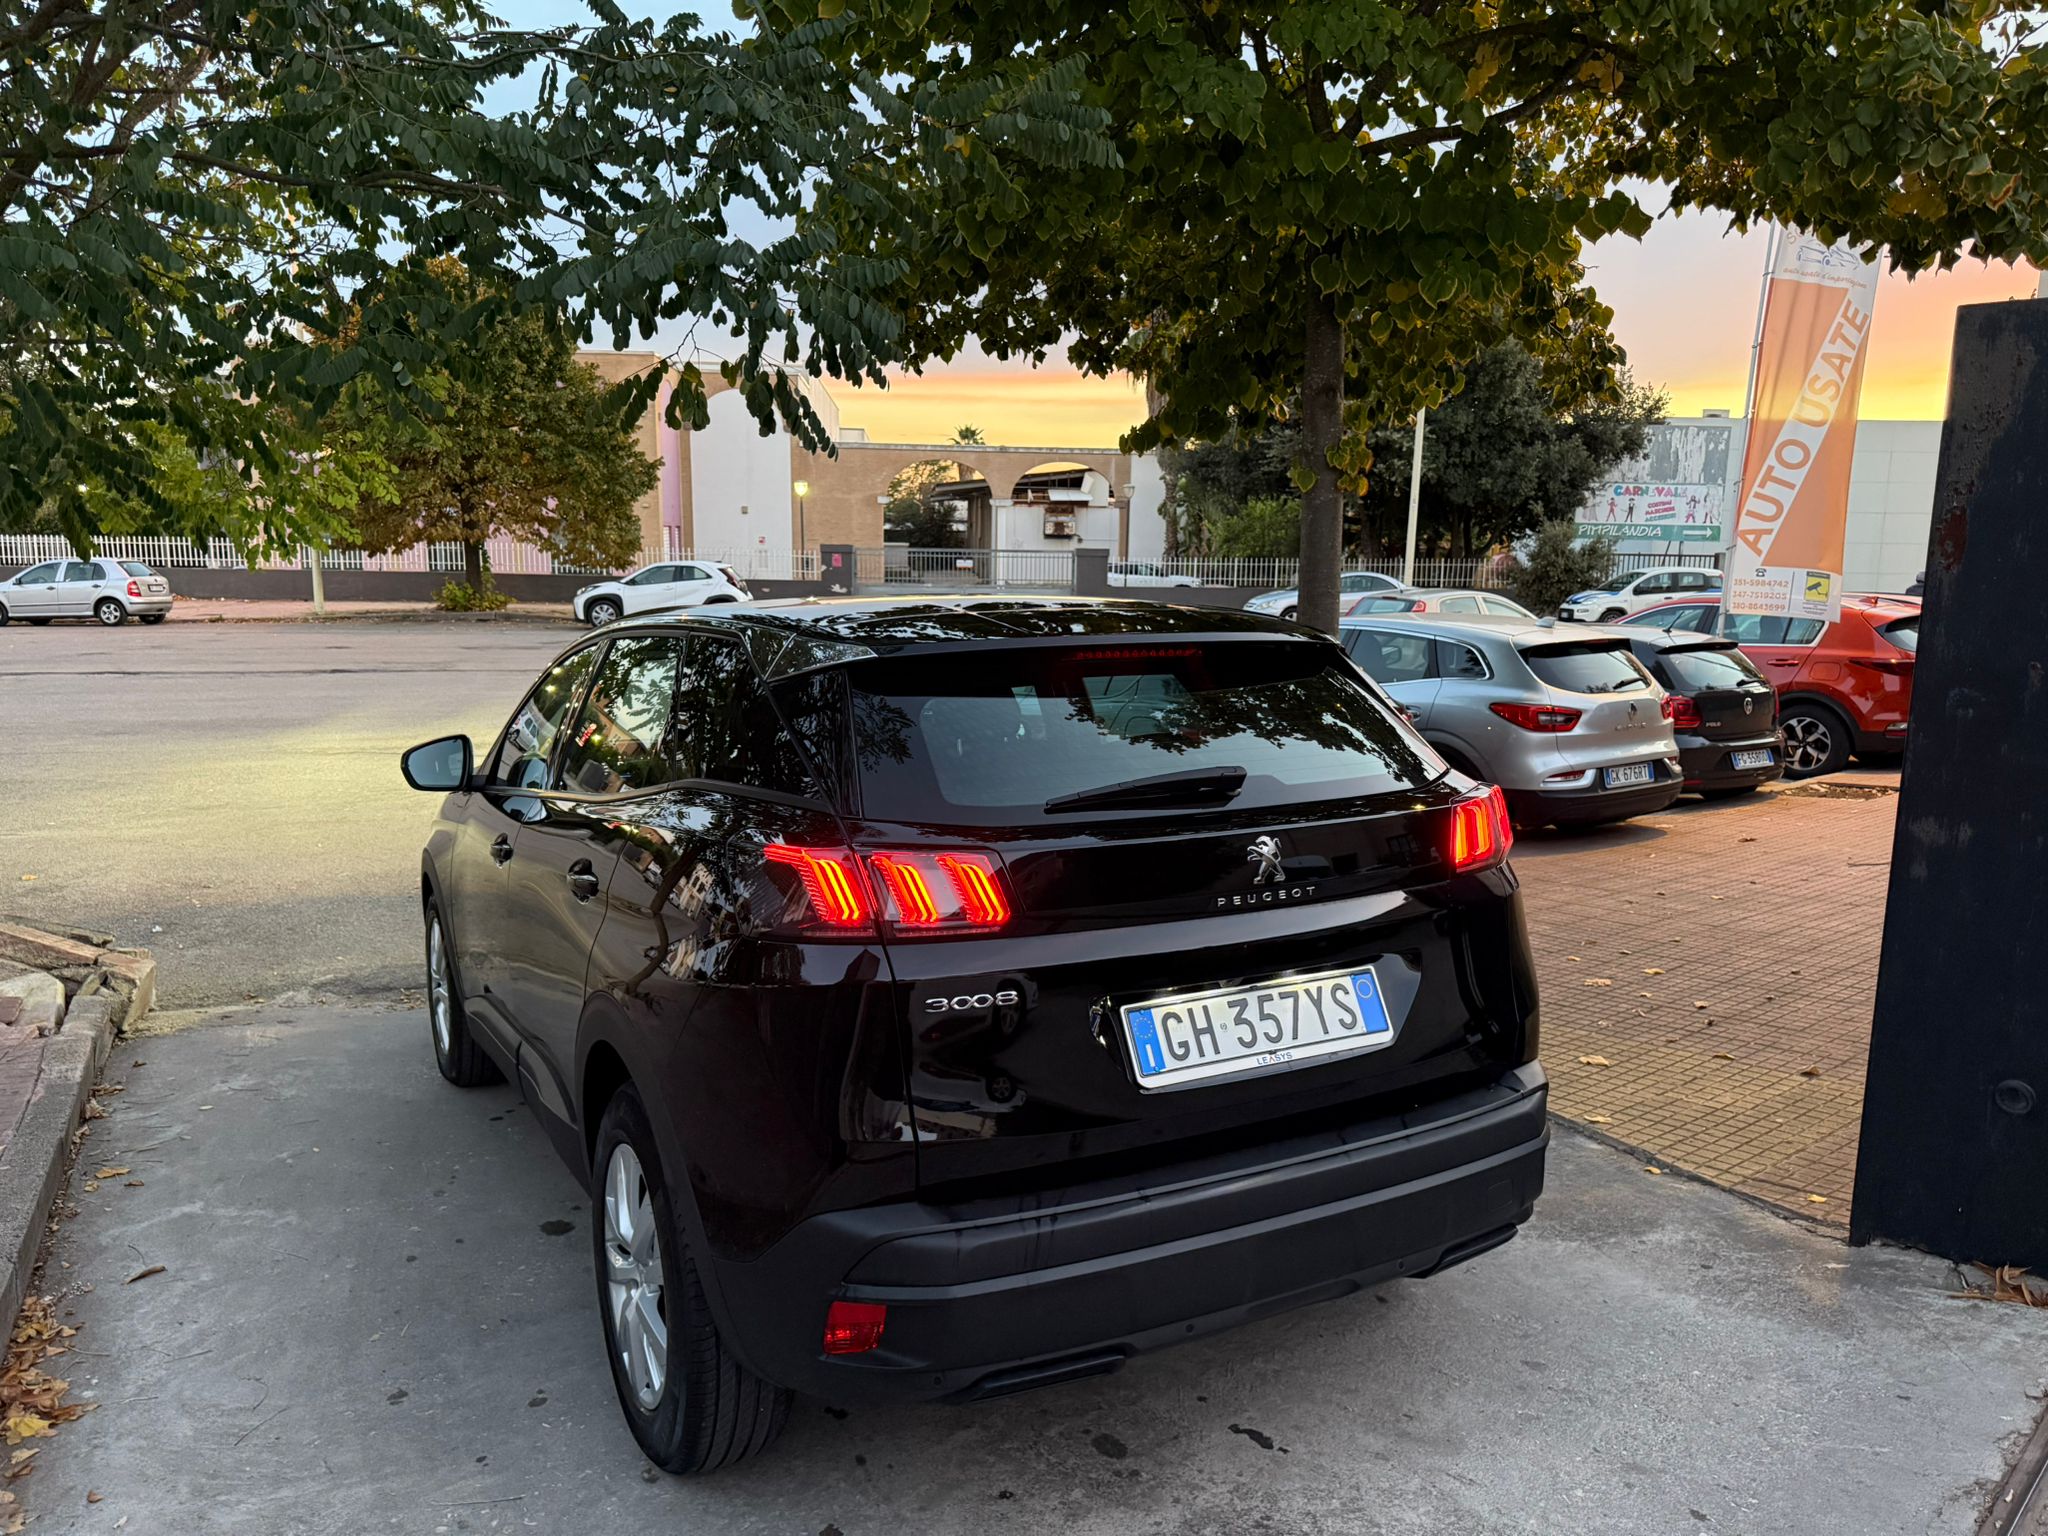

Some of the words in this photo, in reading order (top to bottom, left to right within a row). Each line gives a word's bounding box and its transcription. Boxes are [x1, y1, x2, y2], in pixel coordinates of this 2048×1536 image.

[1738, 438, 1812, 558] AUTO
[1792, 299, 1870, 428] USATE
[1578, 524, 1662, 536] PIMPILANDIA
[1623, 765, 1648, 781] 676RT
[1217, 886, 1316, 908] PEUGEOT
[925, 991, 1018, 1012] 3008
[1161, 1004, 1221, 1062] GH
[1228, 982, 1358, 1049] 357YS
[1256, 1051, 1293, 1065] LEASYS
